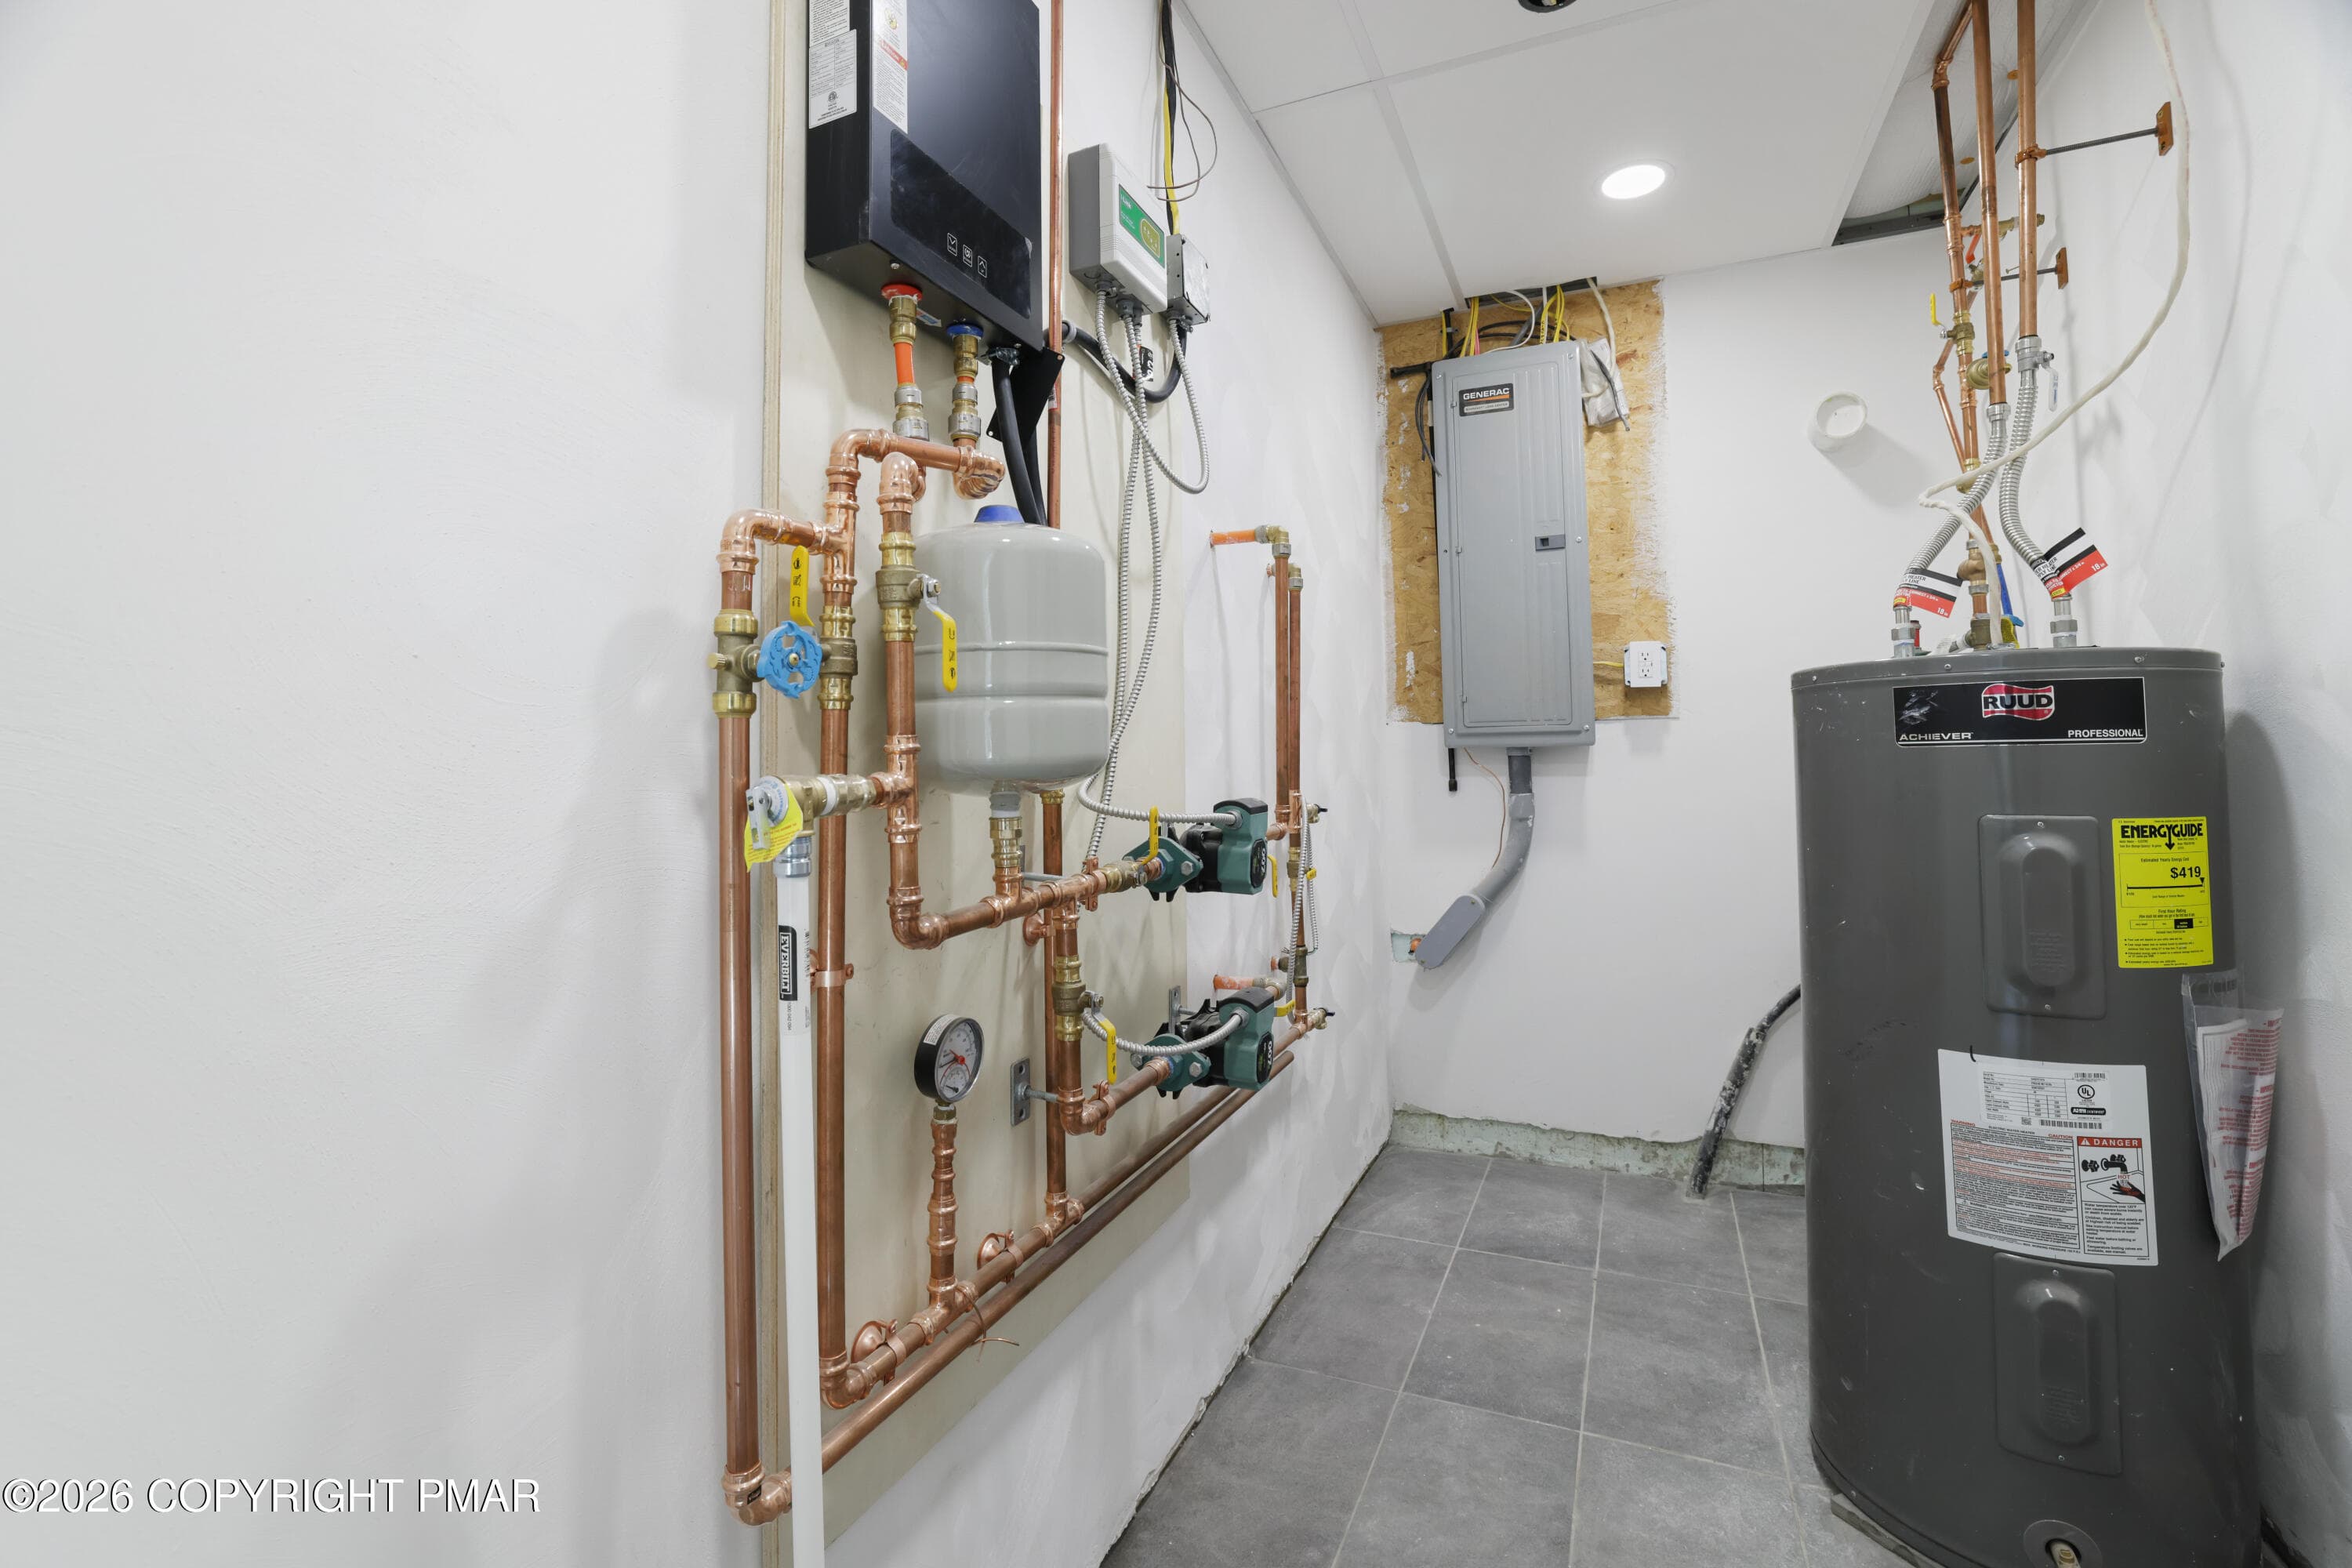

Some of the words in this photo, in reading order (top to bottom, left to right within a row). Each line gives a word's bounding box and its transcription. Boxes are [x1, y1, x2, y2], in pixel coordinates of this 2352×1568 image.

[1463, 387, 1510, 400] GENERAC
[2092, 563, 2100, 572] 18
[1984, 694, 2053, 710] RUUD
[1899, 731, 1973, 741] ACHIEVER
[2067, 729, 2143, 739] PROFESSIONAL
[2170, 866, 2201, 879] $419
[780, 935, 790, 992] EVERBILT
